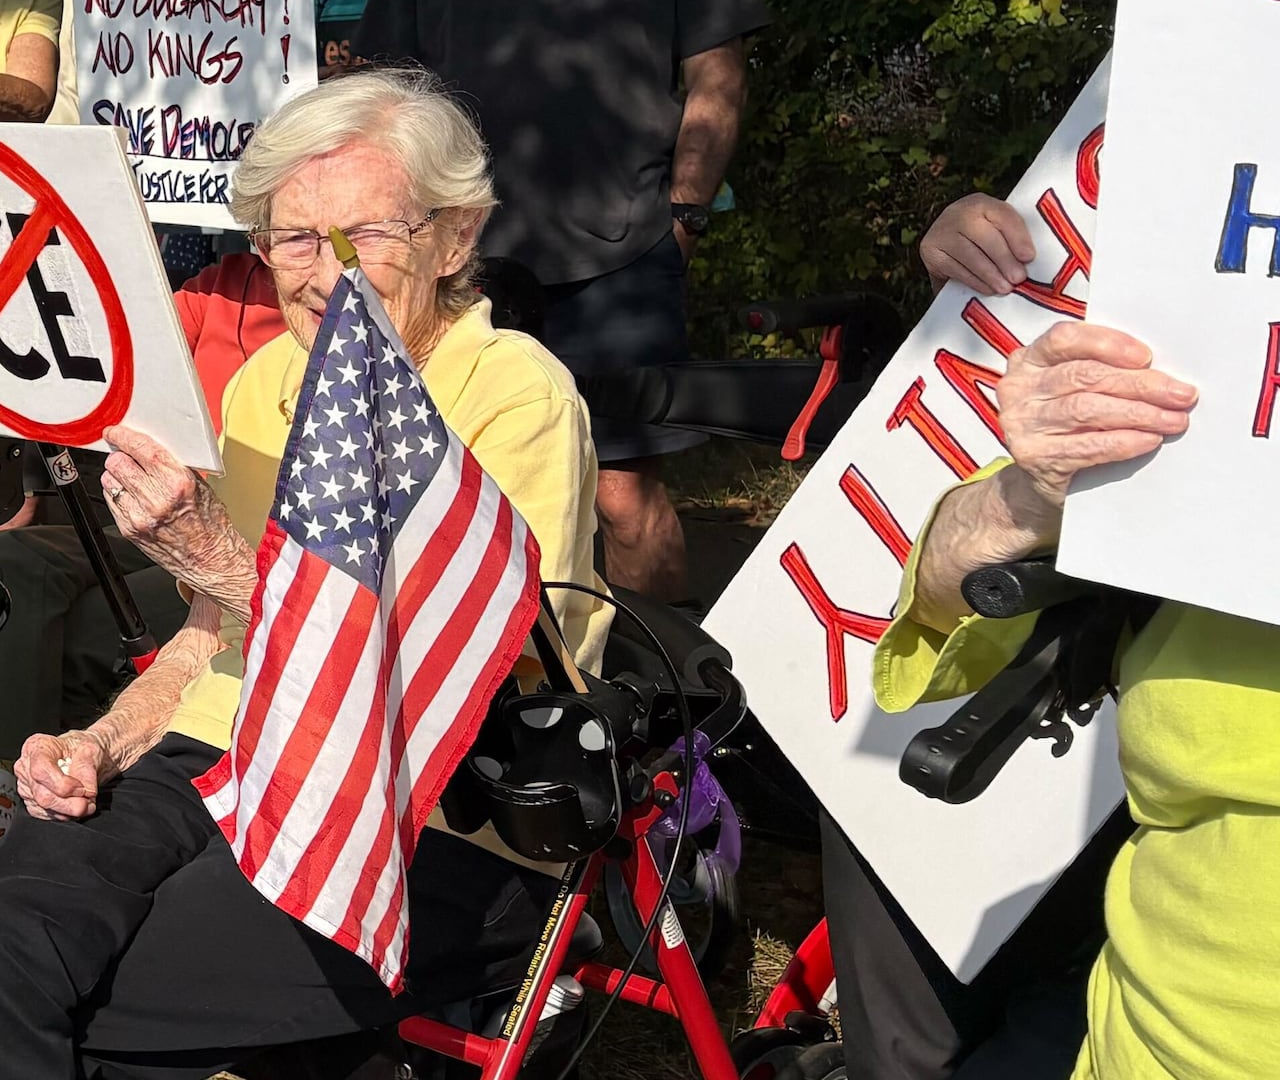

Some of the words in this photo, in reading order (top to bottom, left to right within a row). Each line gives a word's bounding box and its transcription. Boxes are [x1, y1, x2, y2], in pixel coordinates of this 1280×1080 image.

[91, 31, 134, 77] NO
[148, 28, 243, 85] KINGS
[92, 99, 156, 157] SAVE
[199, 168, 230, 204] FOR
[550, 899, 565, 916] Not
[541, 916, 557, 942] Move
[526, 942, 547, 977] Rollator
[515, 977, 534, 1003] While
[502, 1004, 523, 1038] Seated
